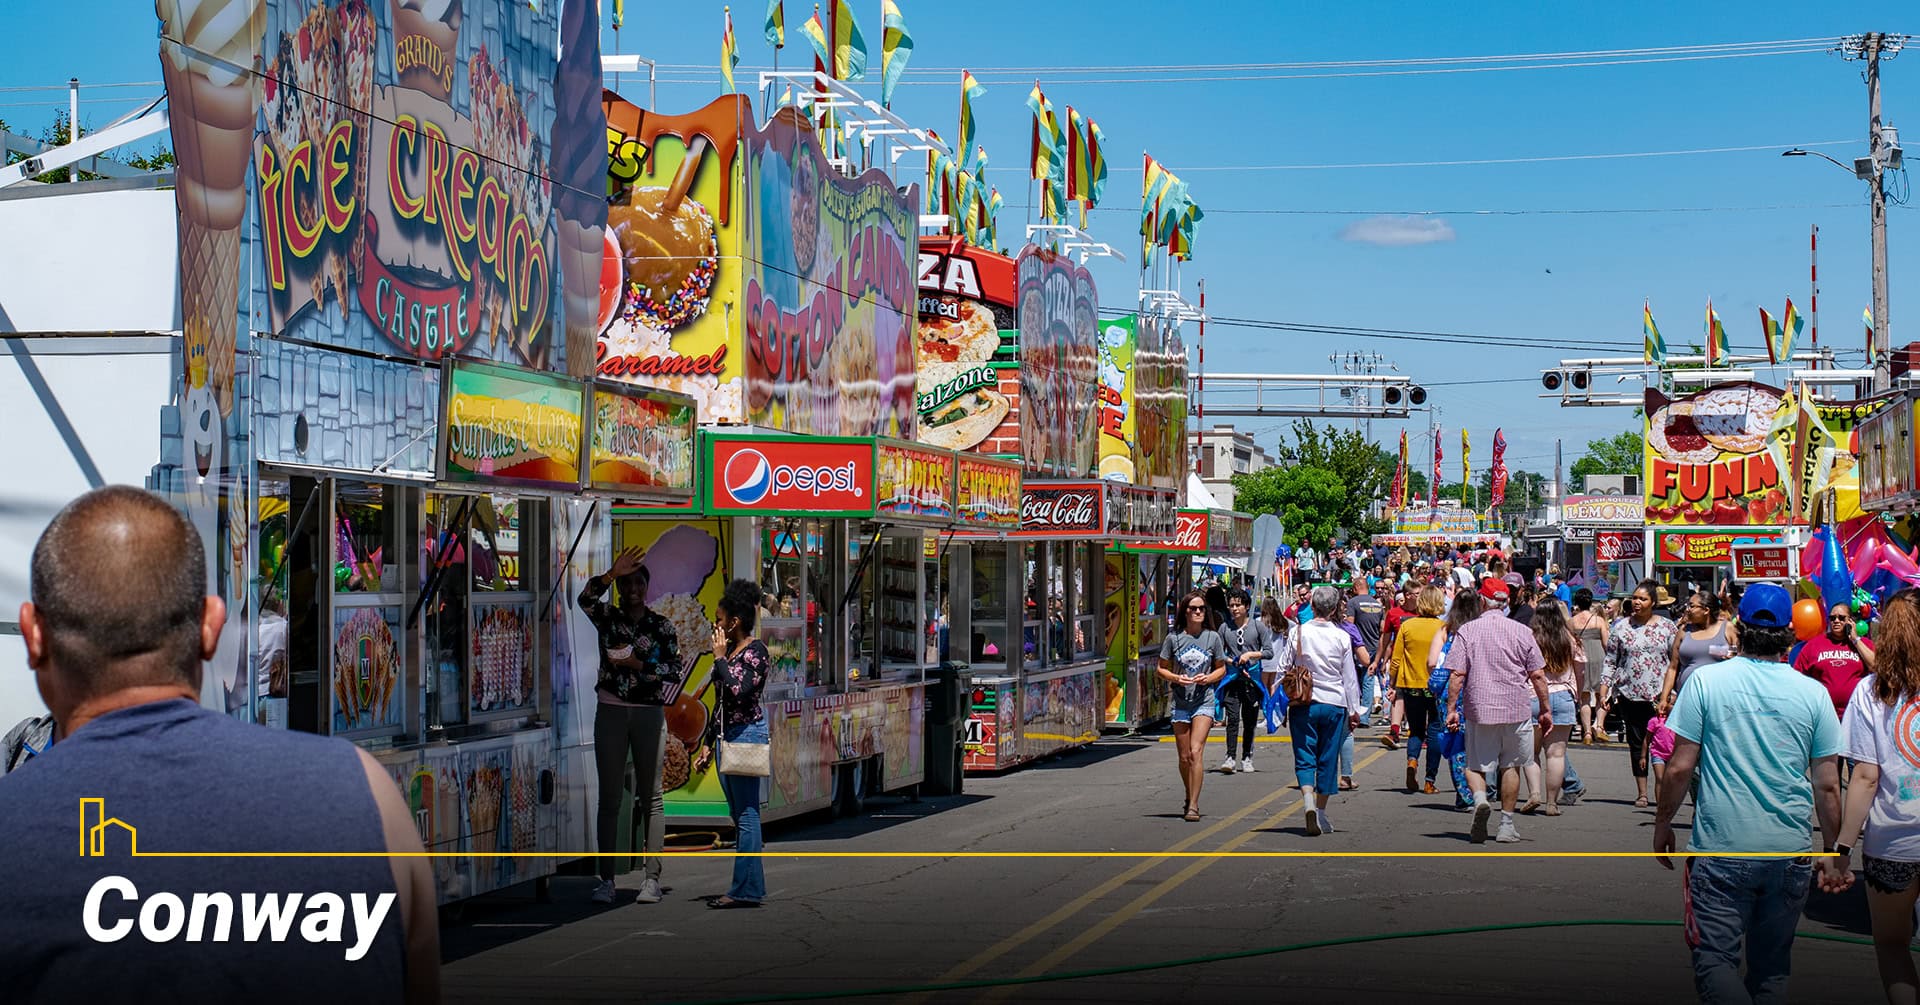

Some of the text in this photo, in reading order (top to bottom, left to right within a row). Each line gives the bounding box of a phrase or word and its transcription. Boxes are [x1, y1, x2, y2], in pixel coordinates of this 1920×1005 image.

[394, 32, 454, 93] GRAND'S
[374, 276, 470, 352] CASTLE
[746, 254, 844, 383] COTTON
[1045, 272, 1076, 332] PIZZA
[917, 366, 996, 411] alzone
[451, 398, 518, 460] Sundaes
[536, 391, 579, 455] Cones
[771, 460, 857, 497] pepsi
[894, 454, 944, 507] APPLES
[1052, 493, 1095, 525] Cola
[1688, 535, 1734, 559] CHERRY LIME GRAPE
[1817, 649, 1860, 663] ARKANSAS
